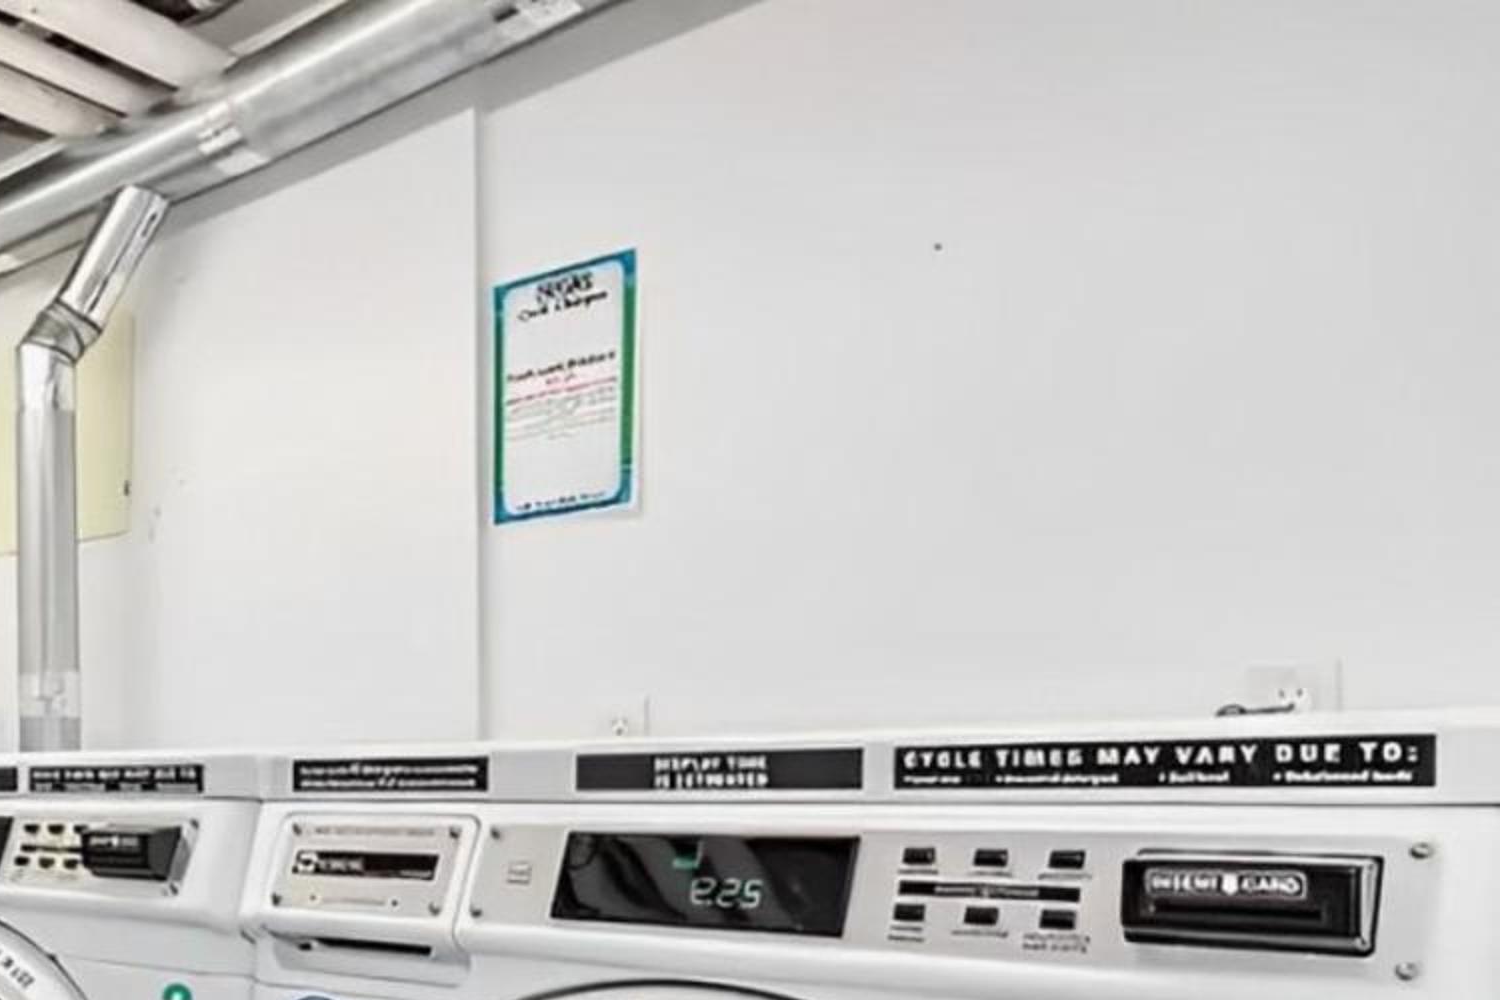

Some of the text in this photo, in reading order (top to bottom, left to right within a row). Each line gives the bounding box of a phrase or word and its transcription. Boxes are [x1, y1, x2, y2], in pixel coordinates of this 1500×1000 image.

[903, 750, 982, 769] CYCLE
[995, 749, 1083, 768] TIMES
[1096, 746, 1160, 766] MAY
[1174, 744, 1258, 765] VARY
[1274, 743, 1341, 763] DUE
